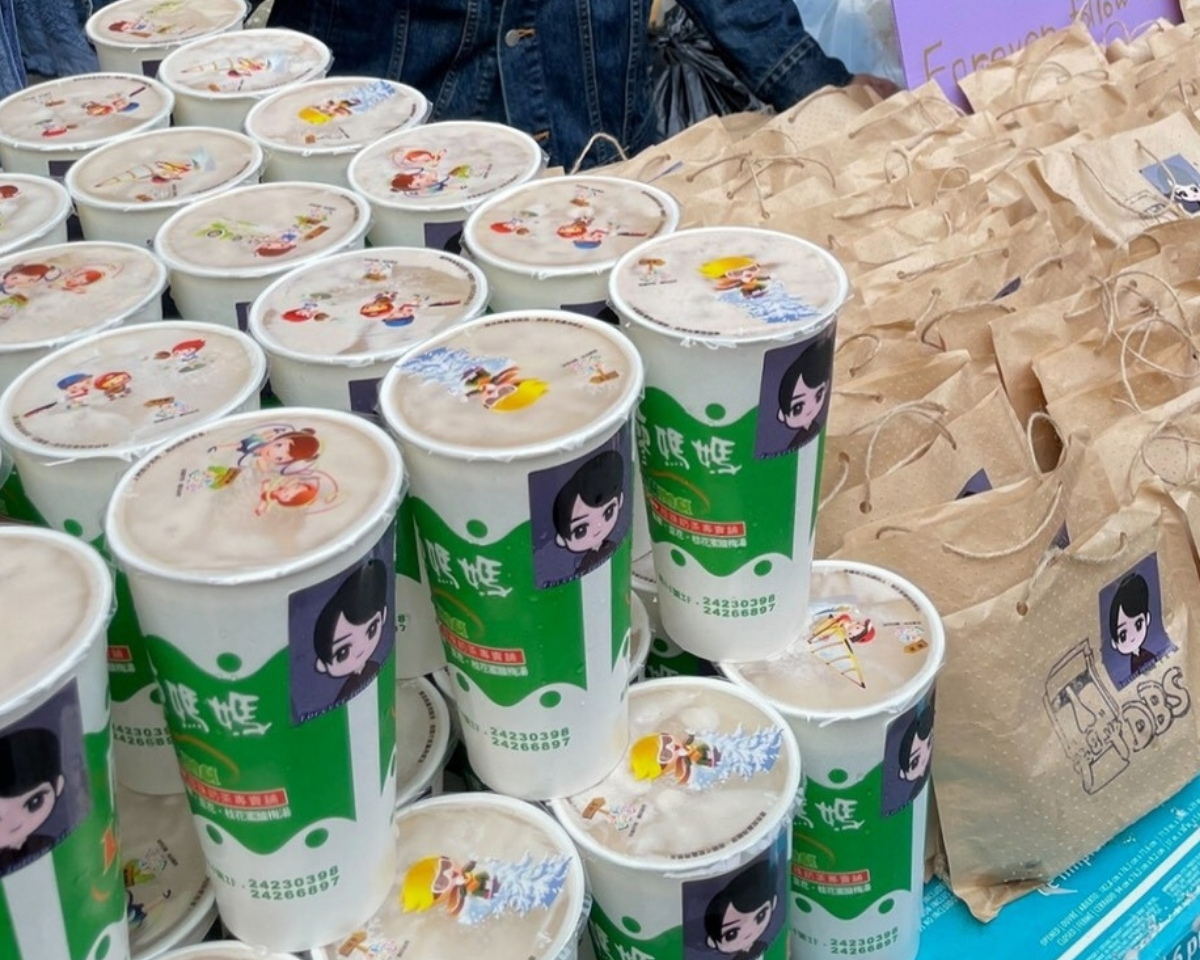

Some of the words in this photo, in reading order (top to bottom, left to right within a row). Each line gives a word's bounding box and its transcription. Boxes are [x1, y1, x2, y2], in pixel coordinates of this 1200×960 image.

[702, 595, 776, 610] 24230398
[703, 603, 776, 618] 24266897
[1121, 666, 1191, 753] DBS
[490, 727, 570, 741] 24230398
[492, 737, 570, 751] 24266897
[248, 866, 339, 889] 24230398
[251, 876, 340, 900] 24266897
